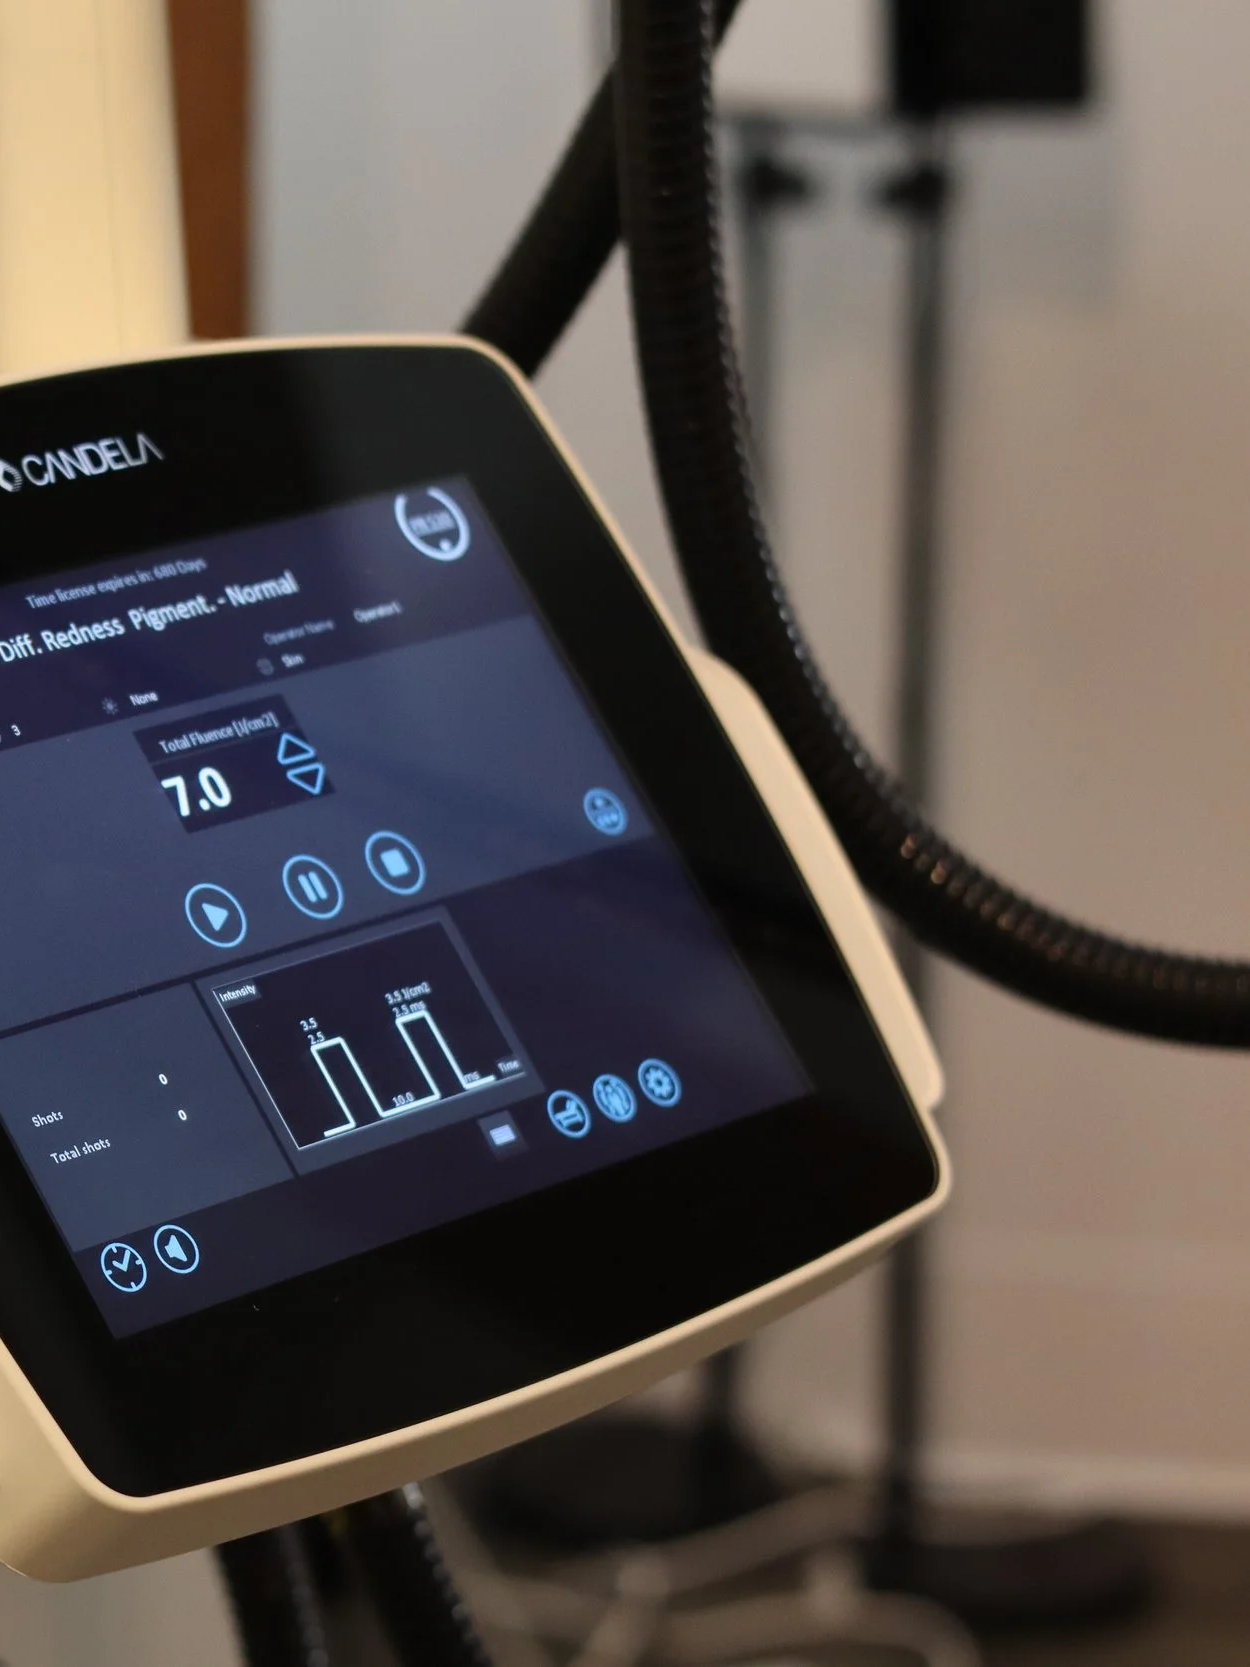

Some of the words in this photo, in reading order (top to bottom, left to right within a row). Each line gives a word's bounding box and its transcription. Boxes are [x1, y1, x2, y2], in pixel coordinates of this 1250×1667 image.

[21, 432, 165, 487] CANDELA
[26, 592, 57, 609] Time
[55, 585, 97, 603] license
[97, 574, 139, 593] expires
[136, 569, 154, 583] in:
[176, 557, 208, 574] Days
[41, 617, 126, 652] Redness
[127, 594, 217, 632] Pigment.
[224, 569, 300, 608] Normal
[280, 653, 306, 669] Skin
[129, 691, 159, 706] None
[10, 723, 22, 737] 3
[158, 734, 191, 754] Total
[189, 725, 234, 747] Fluence
[232, 711, 280, 738] [J/cm2]
[161, 766, 232, 818] 7.0
[218, 984, 256, 1002] Intensity
[384, 990, 403, 1005] 3.5
[392, 1004, 410, 1018] 2.5
[409, 1000, 427, 1013] ms
[299, 1017, 318, 1031] 3.5
[307, 1031, 326, 1045] 2.5
[497, 1060, 520, 1072] Time
[31, 1110, 64, 1128] Shots
[158, 1073, 168, 1085] 0
[392, 1091, 415, 1107] 10.0
[50, 1145, 82, 1165] Total
[81, 1138, 111, 1156] shots
[177, 1109, 188, 1121] 0
